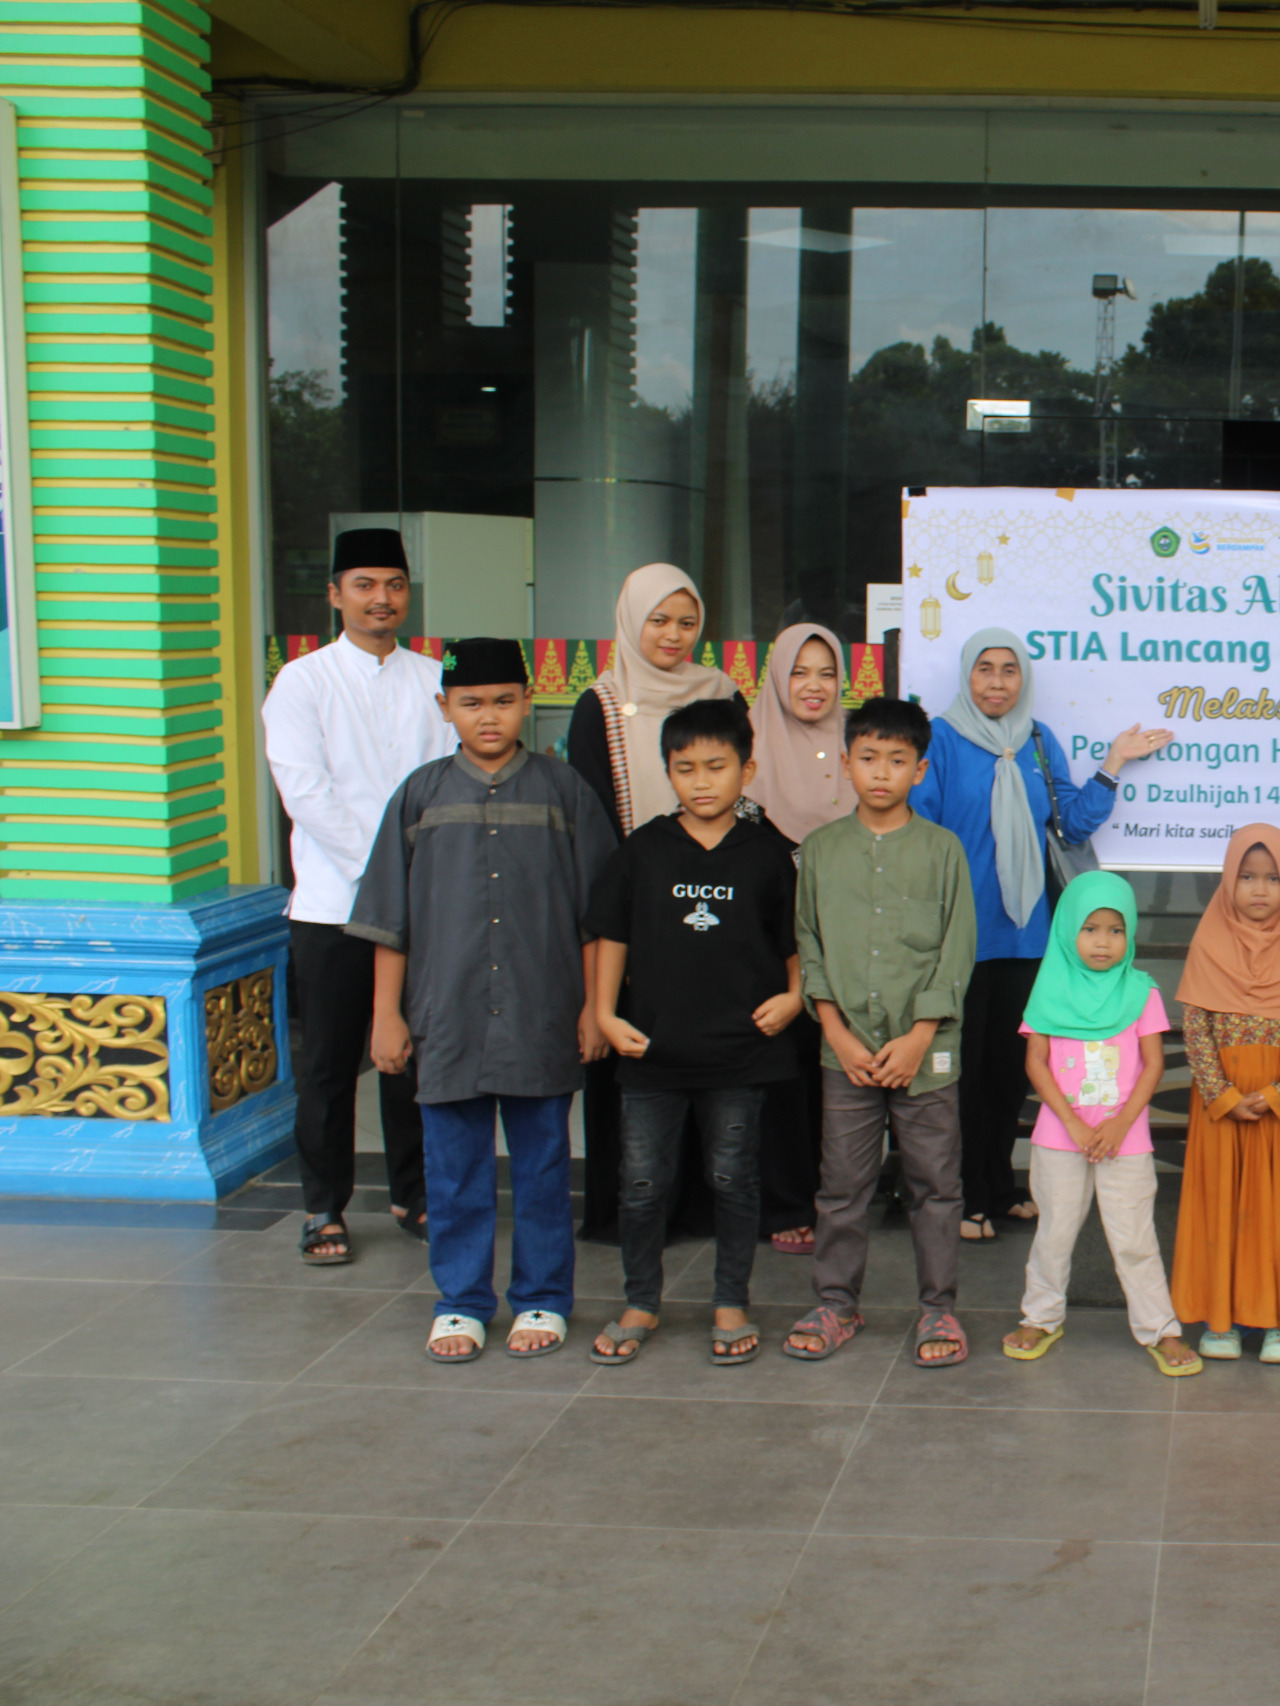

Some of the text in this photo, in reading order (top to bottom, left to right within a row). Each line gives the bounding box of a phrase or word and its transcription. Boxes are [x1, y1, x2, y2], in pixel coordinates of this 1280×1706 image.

[1090, 573, 1228, 617] Sivitas
[1026, 630, 1108, 662] STIA
[1120, 631, 1271, 672] Lancang
[1147, 784, 1249, 808] Dzulhijah
[1124, 822, 1160, 838] Mari
[1164, 823, 1195, 839] kita
[672, 883, 734, 900] GUCCI
